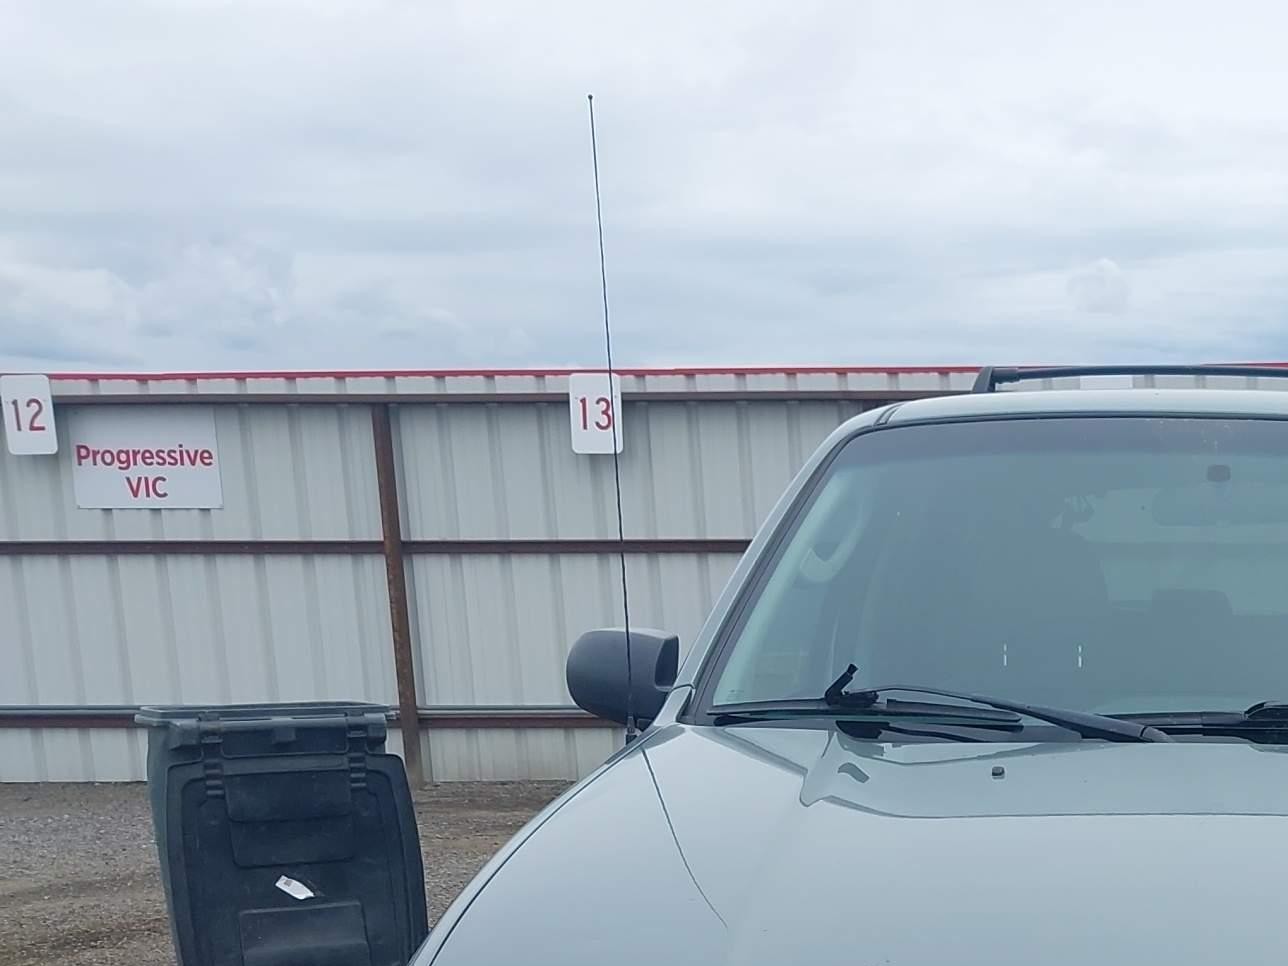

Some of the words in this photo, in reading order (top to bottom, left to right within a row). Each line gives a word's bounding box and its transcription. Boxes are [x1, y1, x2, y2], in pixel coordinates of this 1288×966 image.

[11, 398, 46, 432] 12
[579, 396, 612, 431] 13
[75, 444, 214, 471] Progressive
[125, 476, 168, 499] VIC
